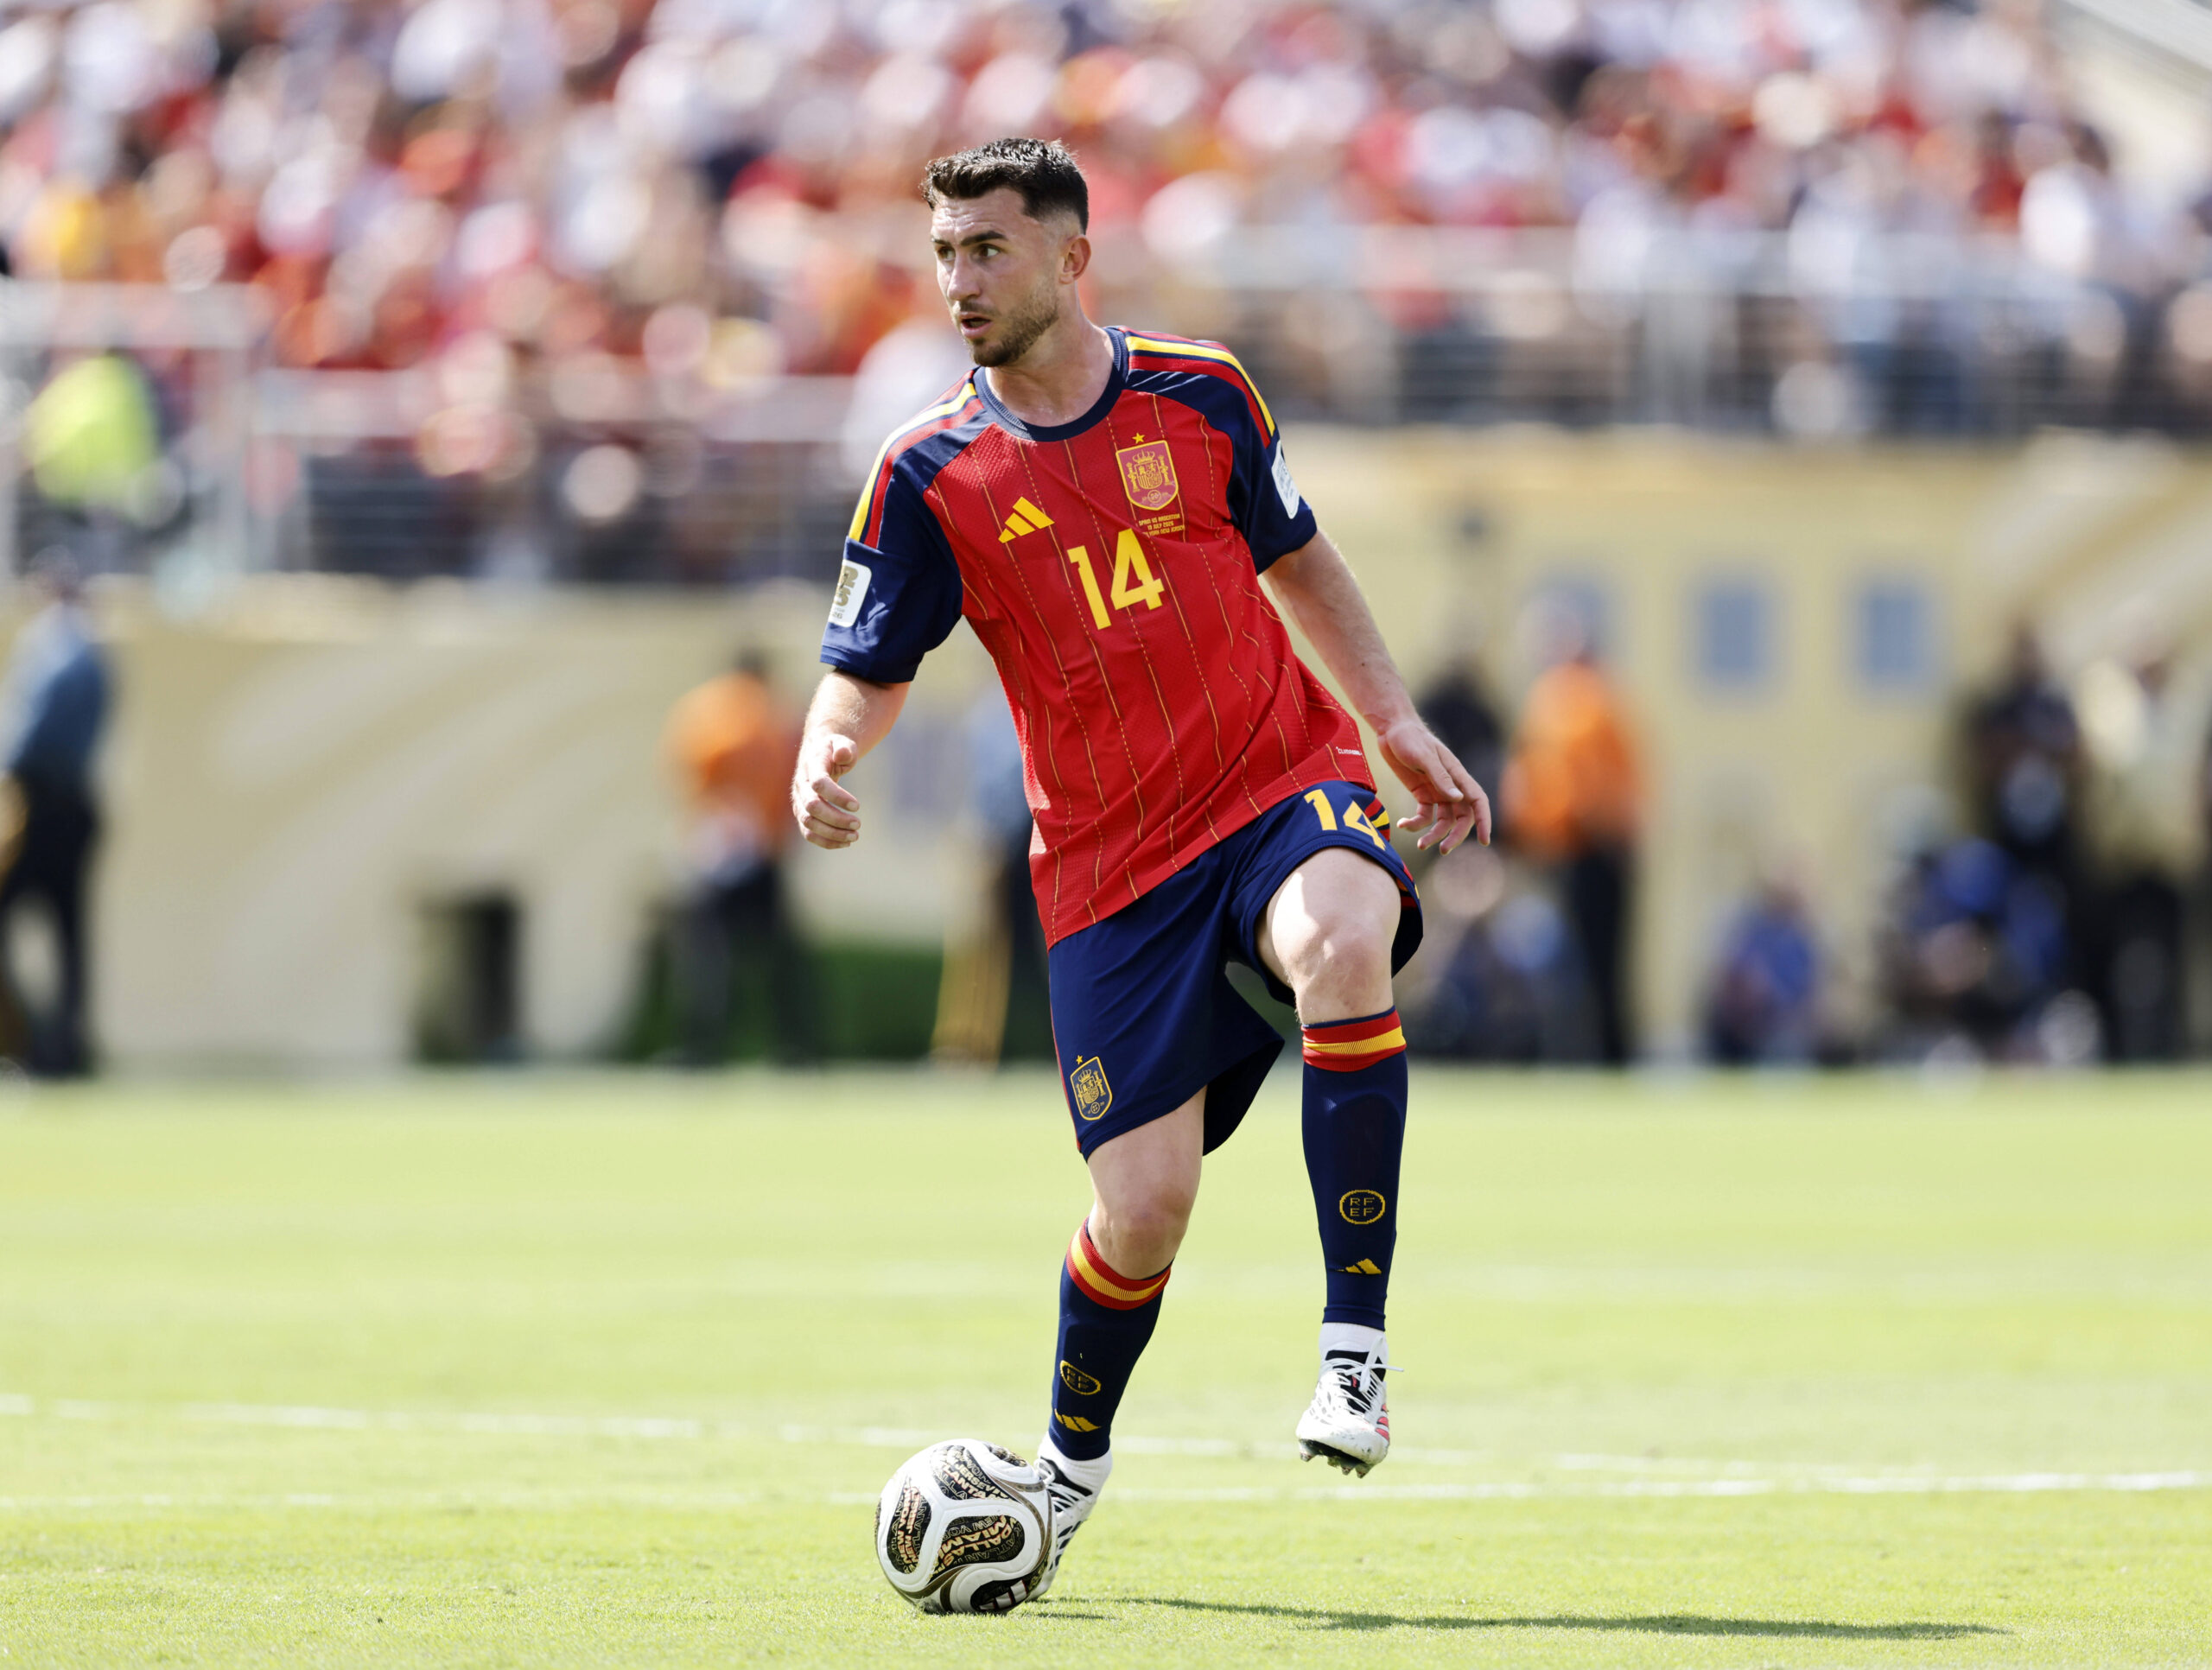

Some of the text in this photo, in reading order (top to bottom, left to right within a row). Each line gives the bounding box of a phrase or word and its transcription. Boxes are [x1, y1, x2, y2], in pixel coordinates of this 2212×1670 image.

[1066, 527, 1166, 631] 14
[1303, 788, 1387, 851] 14
[938, 1514, 1007, 1559] MIAMI
[942, 1522, 1013, 1566] DALLAS
